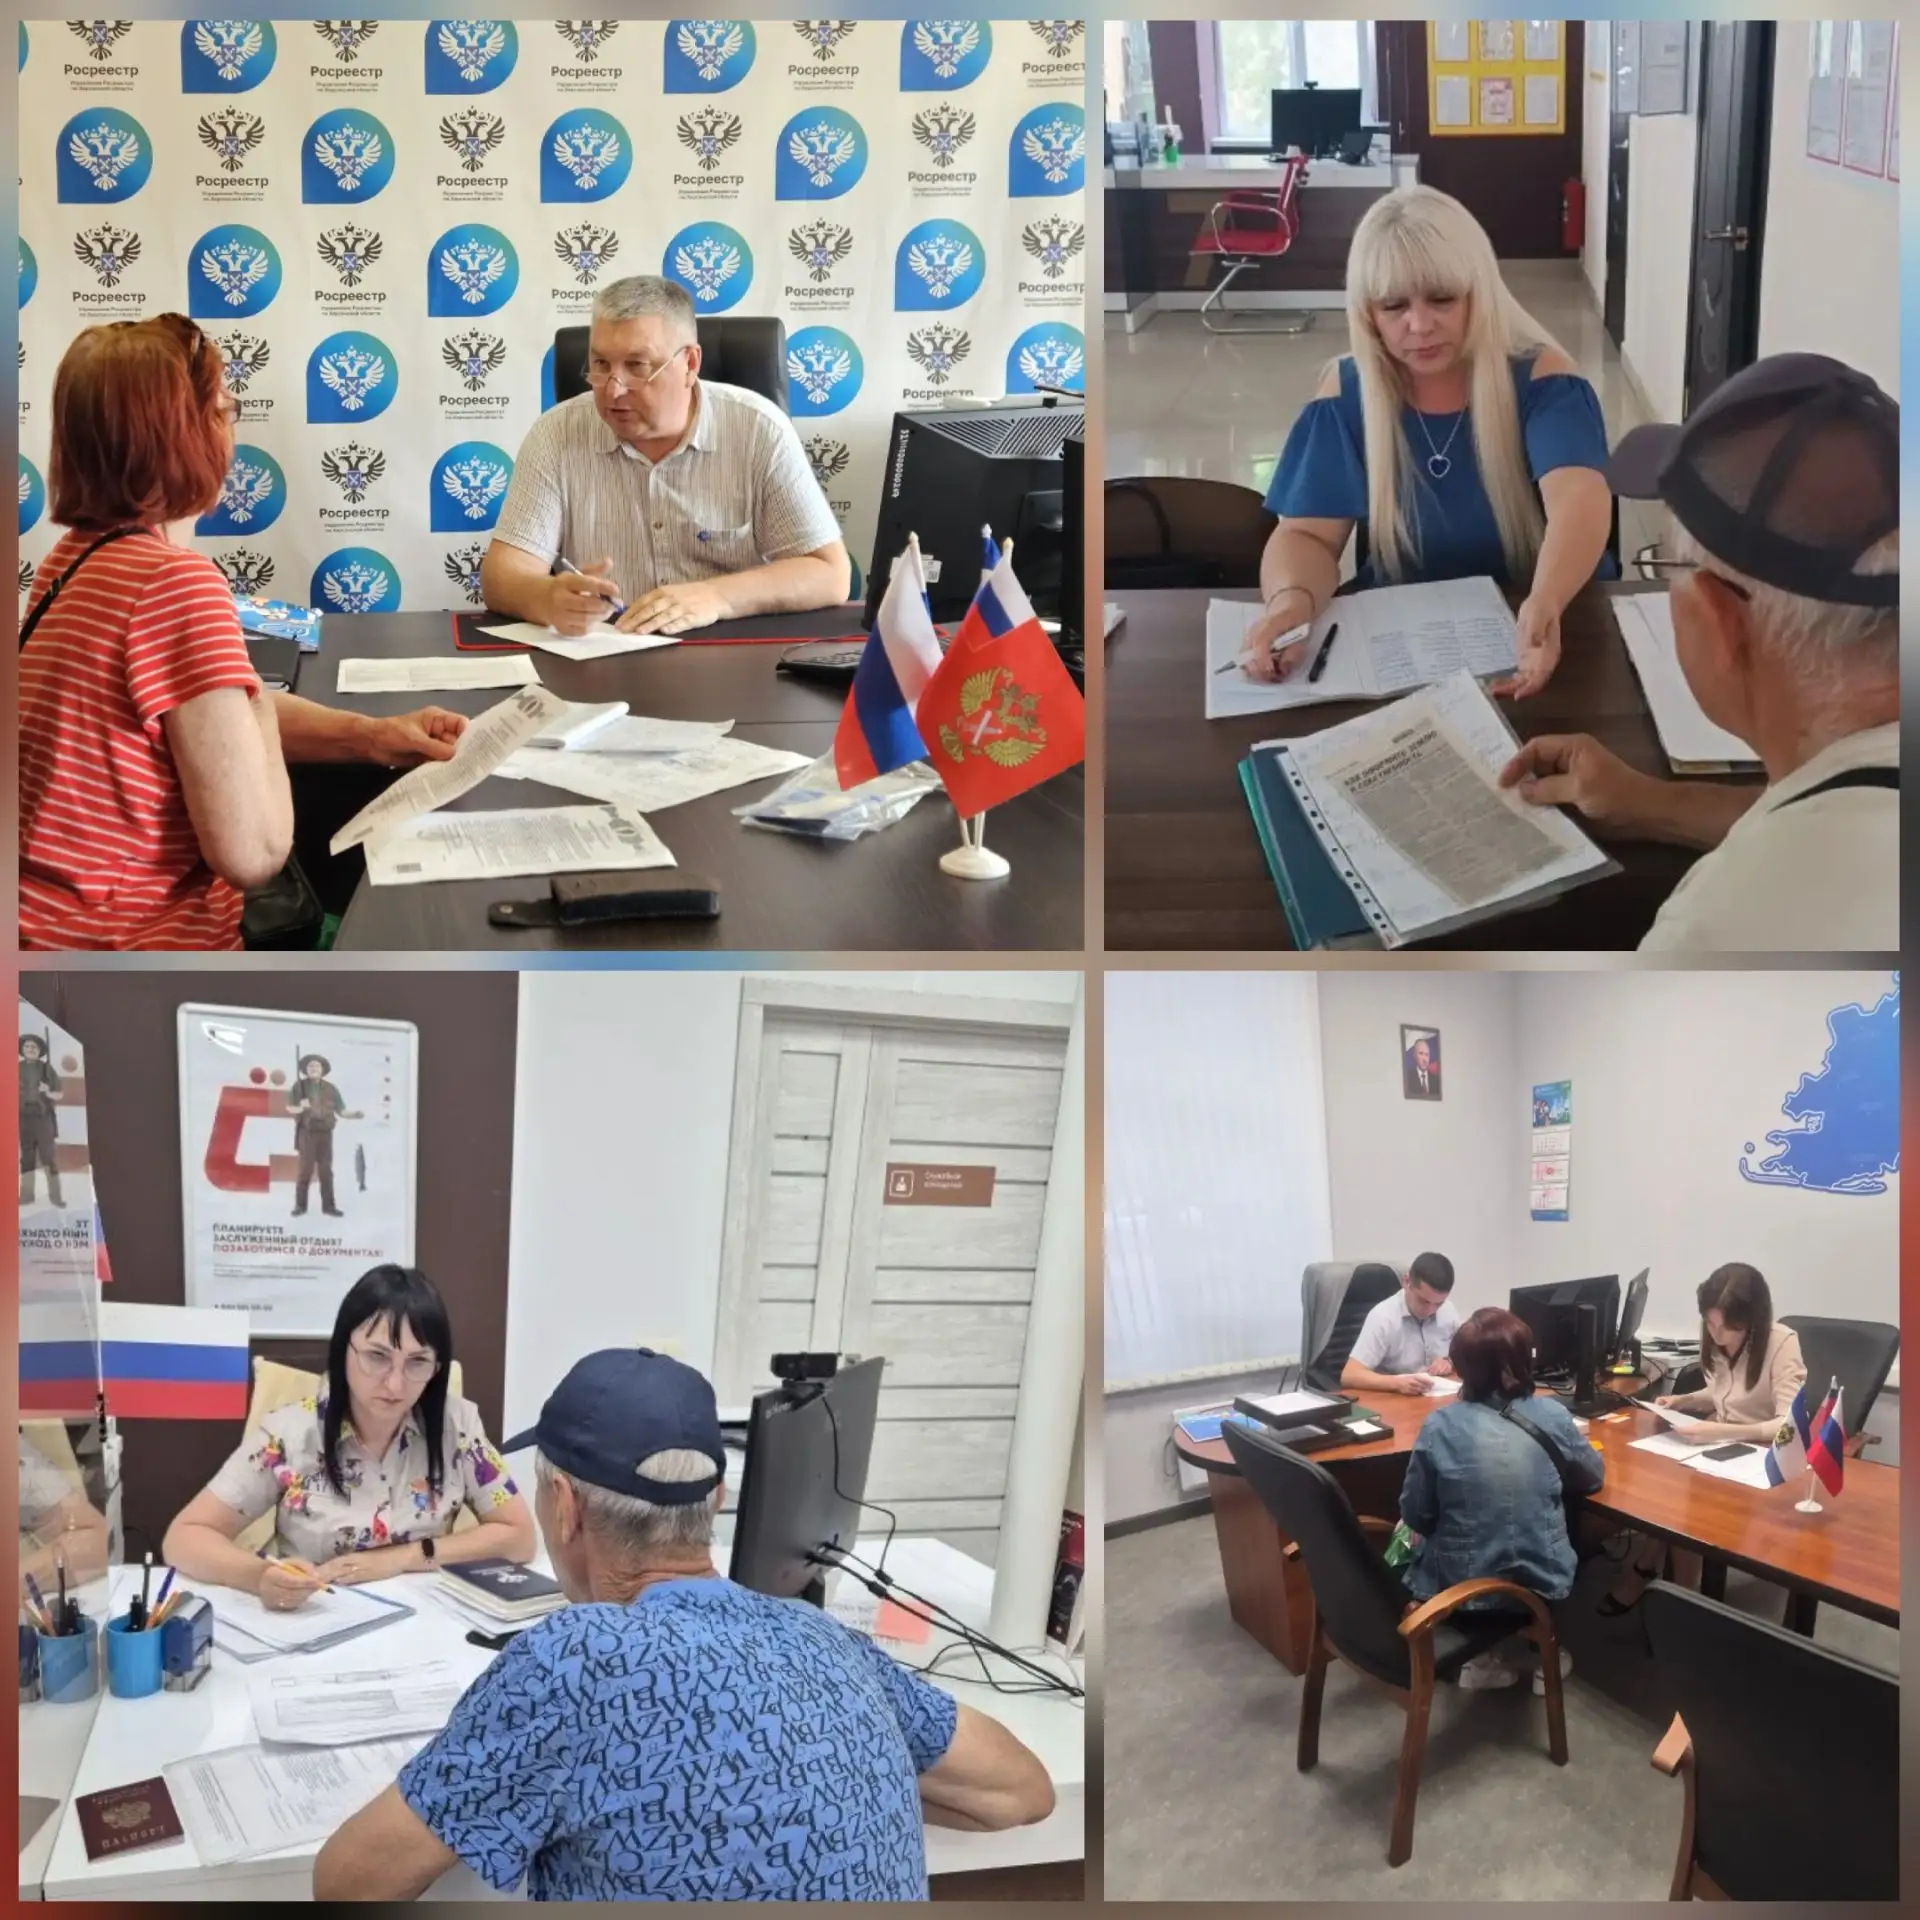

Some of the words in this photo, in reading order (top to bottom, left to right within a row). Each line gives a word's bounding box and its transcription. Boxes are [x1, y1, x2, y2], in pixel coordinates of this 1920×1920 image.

[63, 63, 139, 78] Росреестр
[310, 65, 383, 79] Росреестр
[551, 65, 623, 79] Росреестр
[788, 64, 860, 78] Росреестр
[1022, 62, 1085, 75] Росреест
[195, 175, 269, 189] Росреестр
[436, 175, 509, 189] Росреестр
[673, 173, 744, 187] Росреестр
[907, 170, 977, 185] Росреестр
[72, 291, 147, 305] Росреестр
[314, 290, 387, 304] Росреестр
[551, 288, 599, 303] Росрее
[784, 285, 855, 299] Росреестр
[438, 394, 510, 408] Росреестр
[318, 507, 390, 521] Росреестр
[213, 1222, 284, 1235] ПЛАНИРУЕТЕ
[213, 1233, 297, 1244] ЗАСЛУЖЕННЫЙ
